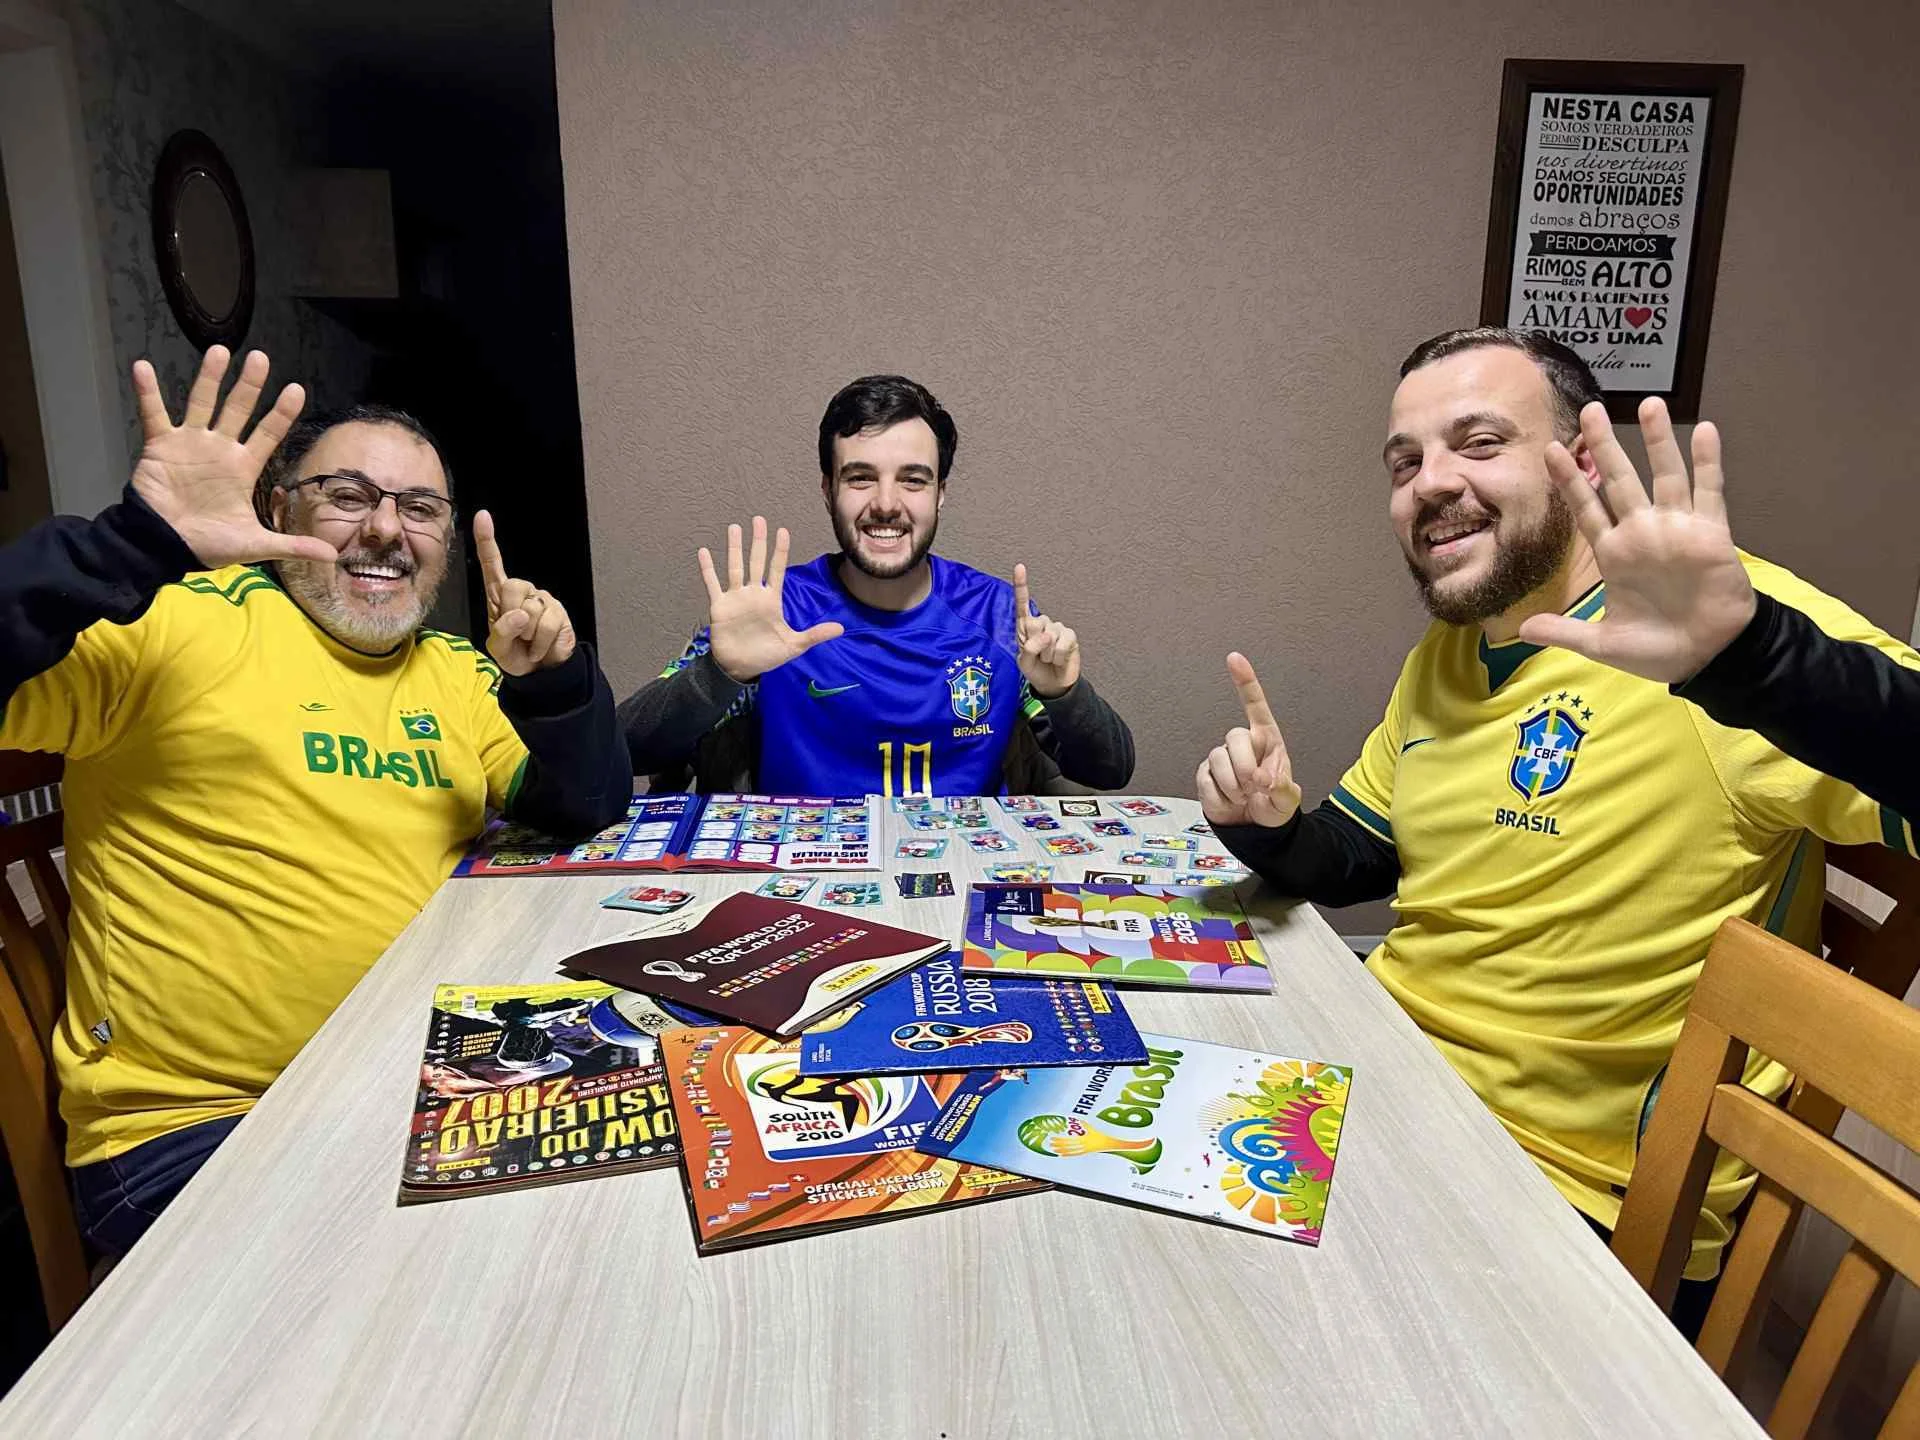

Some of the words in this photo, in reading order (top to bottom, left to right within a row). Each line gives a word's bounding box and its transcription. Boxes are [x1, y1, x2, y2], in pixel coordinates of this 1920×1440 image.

[1543, 97, 1621, 122] NESTA
[1630, 101, 1694, 123] CASA
[1540, 120, 1590, 133] SOMOS
[1594, 123, 1694, 137] VERDADEIROS
[1539, 133, 1581, 144] PEDIMOS
[1581, 136, 1689, 153] DESCULPA
[1537, 155, 1569, 169] nos
[1574, 152, 1688, 171] divertimos
[1535, 168, 1594, 182] DAMOS
[1598, 171, 1686, 185] SEGUNDAS
[1533, 181, 1684, 206] OPORTUNIDADES
[1529, 212, 1574, 227] damos
[1579, 206, 1680, 235] abraços
[1545, 234, 1657, 253] PERDOAMOS
[1525, 258, 1587, 277] RIMOS
[1561, 278, 1585, 287] BEM
[1591, 260, 1672, 289] ALTO
[1522, 288, 1577, 303] SOMOS
[1580, 292, 1670, 305] PACIENTES
[1607, 332, 1663, 345] UMA
[963, 688, 980, 697] CBF
[953, 724, 994, 738] BRASIL
[302, 731, 454, 789] BRASIL
[1534, 748, 1559, 760] CBF
[878, 741, 933, 799] 10
[1494, 807, 1560, 836] BRASIL
[1125, 918, 1139, 933] FIFA
[1158, 923, 1176, 943] WORLD
[1169, 911, 1200, 945] 2026
[685, 947, 723, 963] FIFA
[718, 926, 776, 950] WORLD
[774, 913, 802, 928] CUP
[926, 960, 962, 1015] RUSSIA
[963, 978, 998, 1013] 2018
[915, 1003, 927, 1017] FIFA
[578, 1083, 618, 1097] BRASILEIRO
[440, 1075, 574, 1129] 2007
[1072, 1093, 1099, 1116] FIFA
[765, 1120, 840, 1134] AFRICA
[769, 1110, 836, 1123] SOUTH
[944, 1116, 969, 1142] STICKER
[963, 1095, 983, 1117] ALBUM
[796, 1130, 844, 1142] 2010
[883, 1120, 932, 1140] FIF
[936, 1117, 958, 1140] OFFICIAL
[541, 1127, 590, 1158] DO
[804, 1178, 871, 1194] OFFICIAL
[874, 1169, 942, 1188] LICENSED
[807, 1186, 880, 1205] STICKER
[886, 1178, 945, 1195] ALBUM
